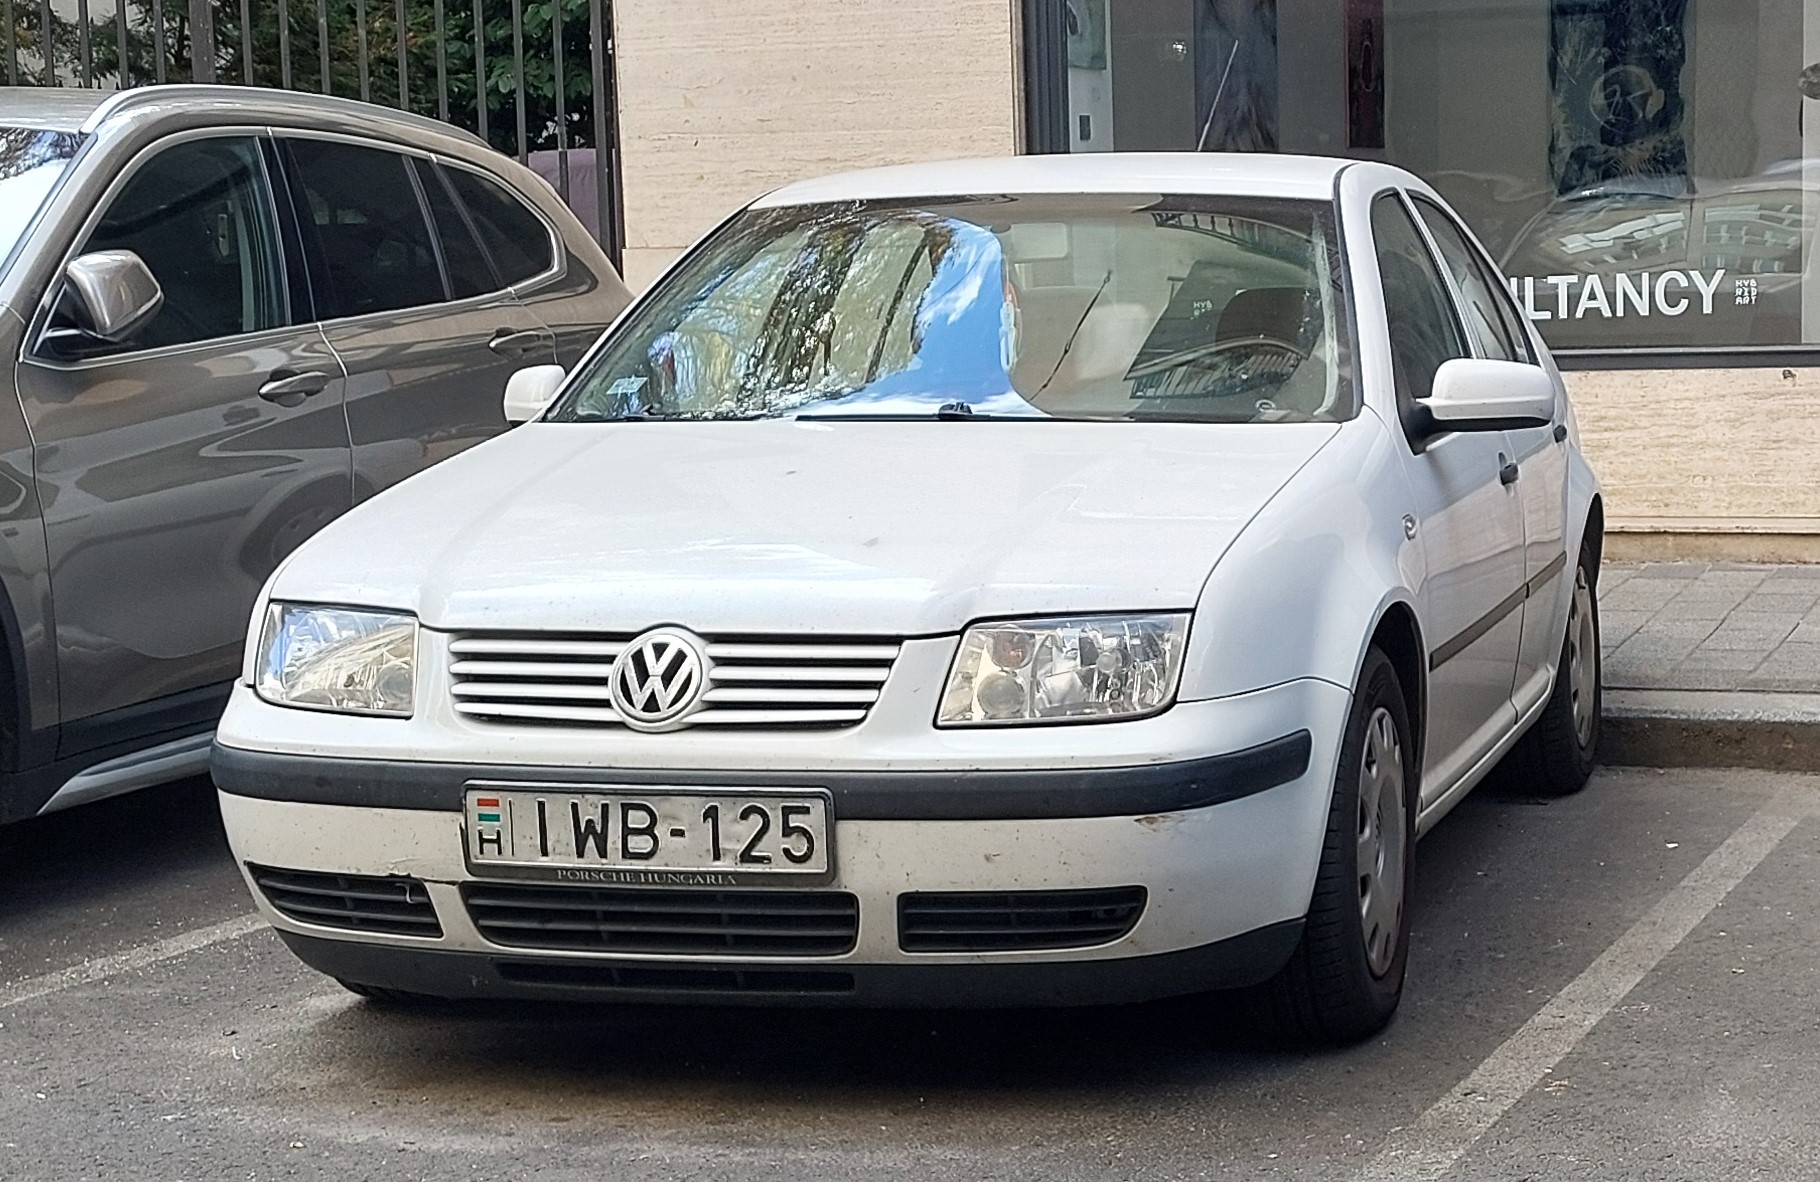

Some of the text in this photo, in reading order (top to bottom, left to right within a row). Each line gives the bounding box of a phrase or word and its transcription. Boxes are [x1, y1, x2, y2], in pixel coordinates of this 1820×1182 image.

[615, 633, 700, 722] VW
[477, 828, 502, 856] H
[536, 798, 816, 865] IWB-125
[556, 868, 737, 886] PORSCHE HUNGARIA
